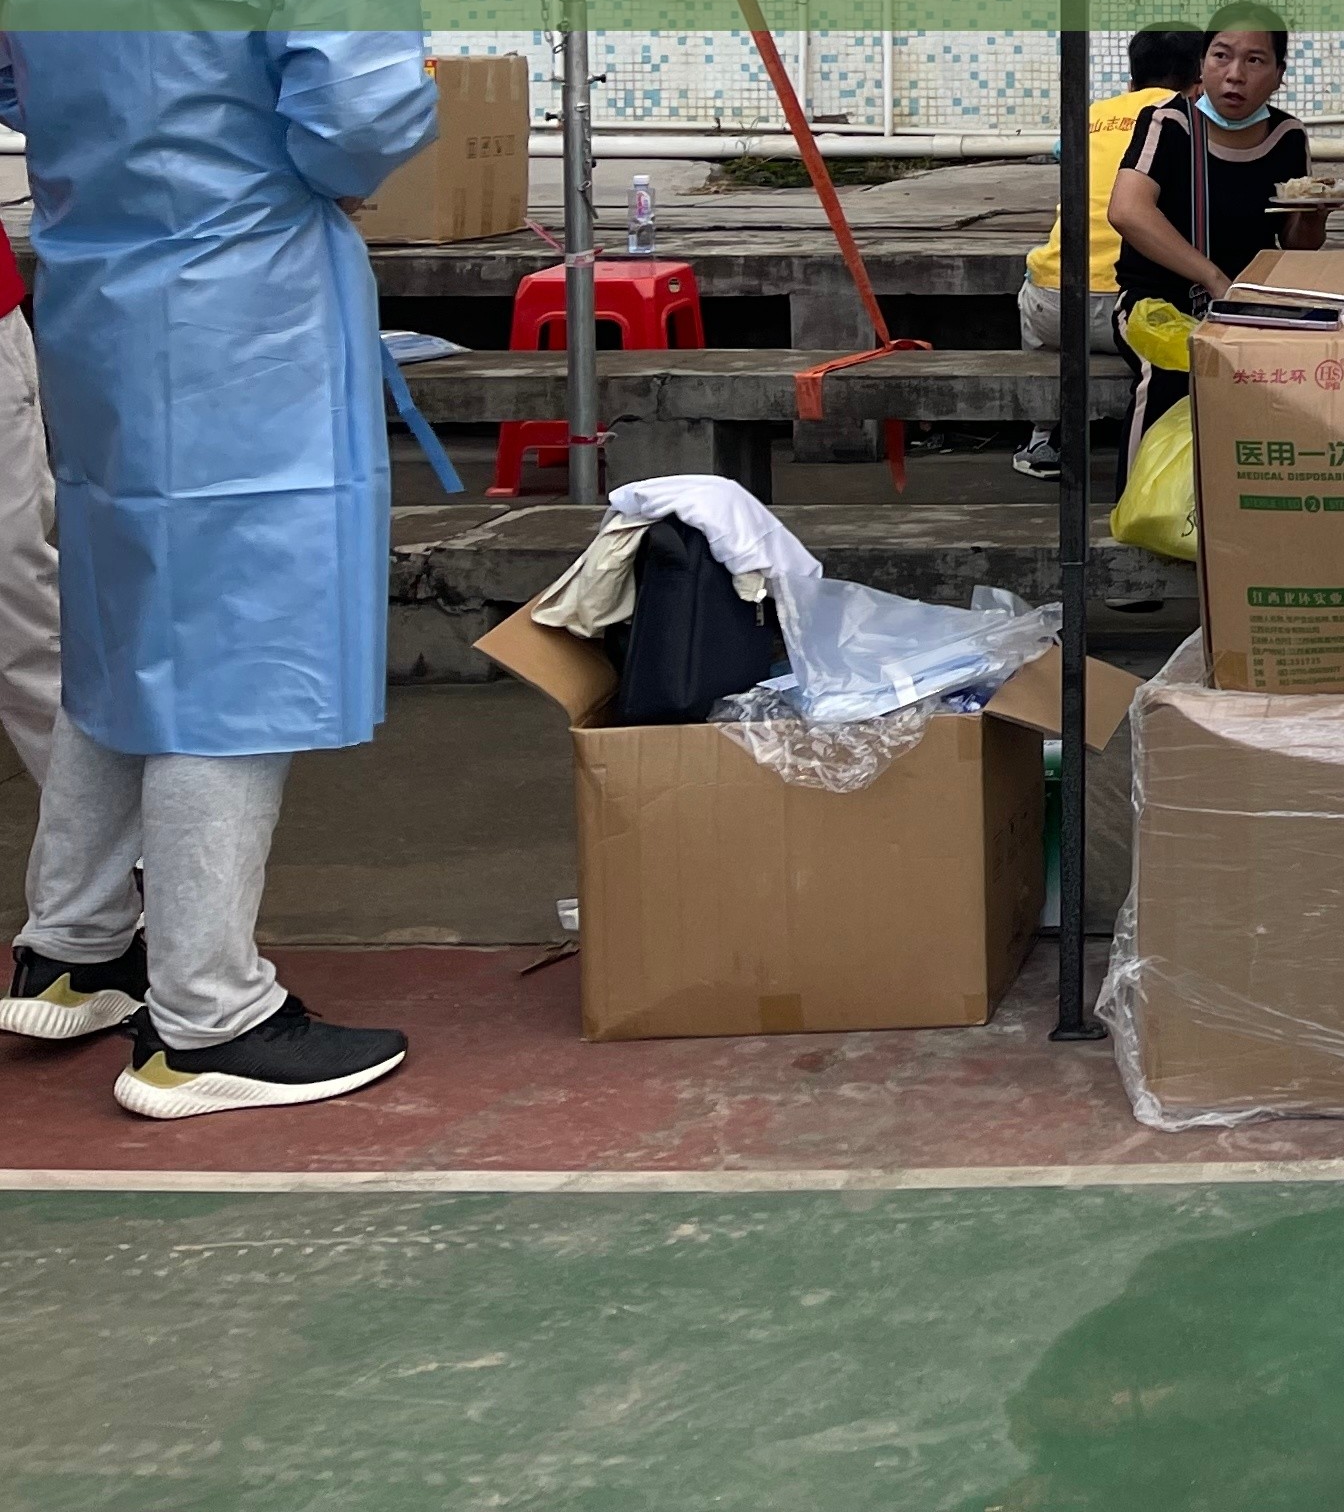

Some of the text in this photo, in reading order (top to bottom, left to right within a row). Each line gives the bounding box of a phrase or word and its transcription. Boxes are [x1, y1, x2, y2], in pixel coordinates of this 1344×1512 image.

[1233, 368, 1307, 384] 关注北环
[1237, 471, 1284, 481] MEDICAL
